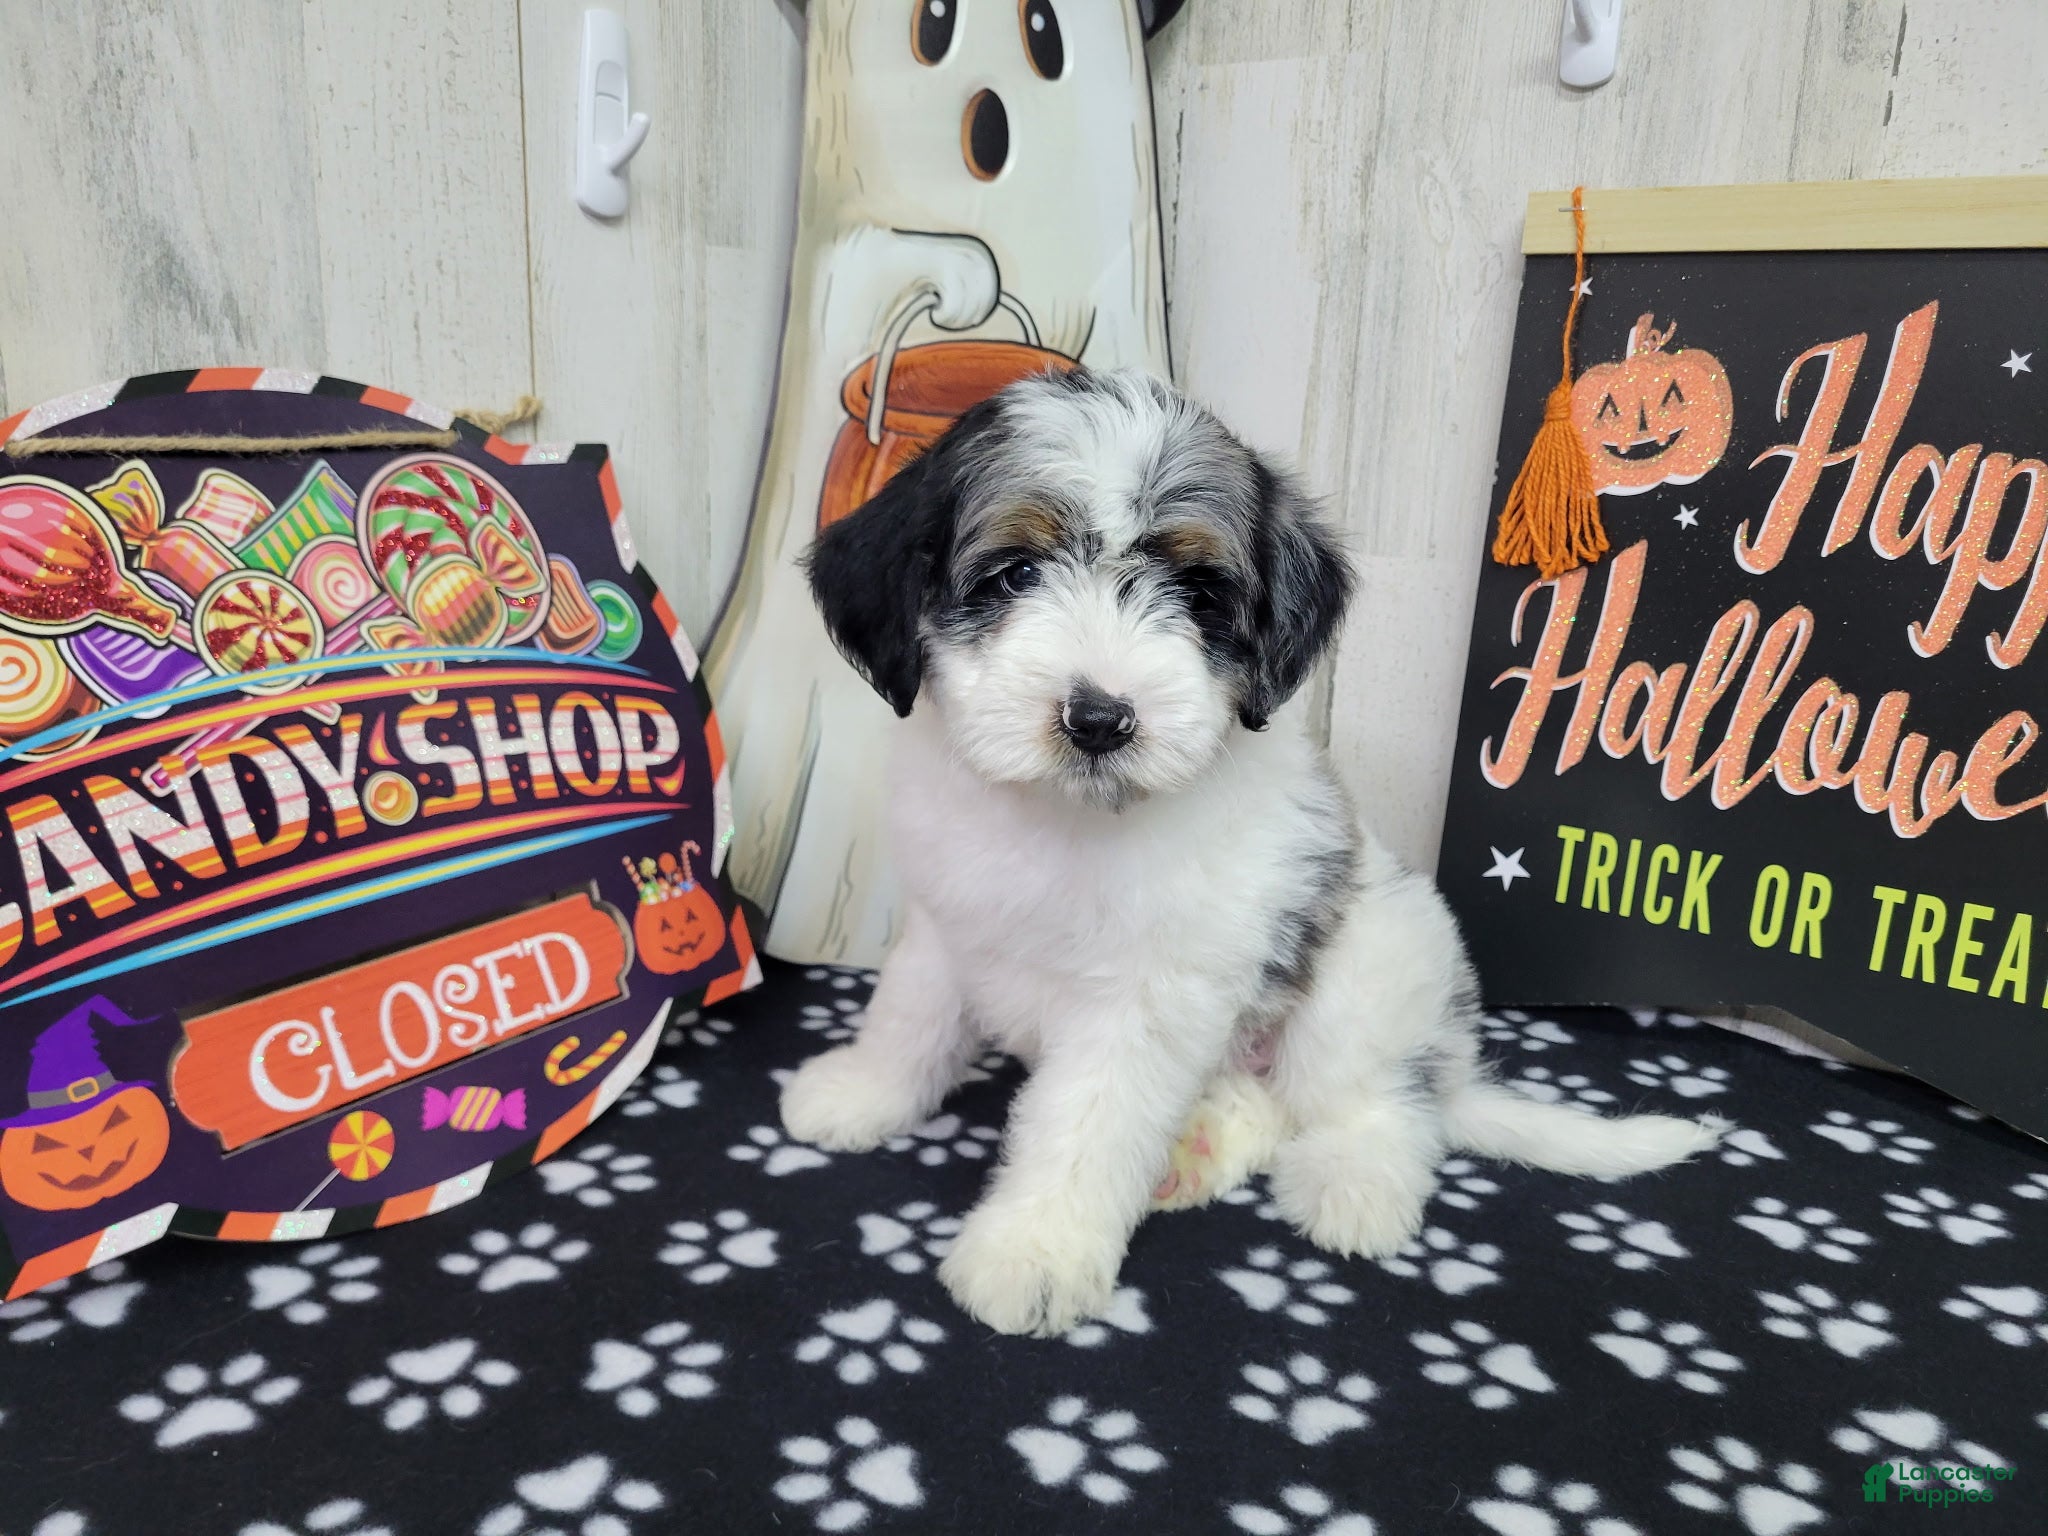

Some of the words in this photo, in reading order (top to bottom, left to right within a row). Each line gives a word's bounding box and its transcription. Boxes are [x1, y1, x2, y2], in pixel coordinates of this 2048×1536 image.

[396, 690, 681, 818] SHOP
[1480, 540, 2048, 838] Hallowe
[1554, 825, 1723, 934] TRICK
[1749, 864, 1833, 959] OR
[1868, 885, 2048, 1010] TREA
[248, 931, 592, 1112] CLOSED
